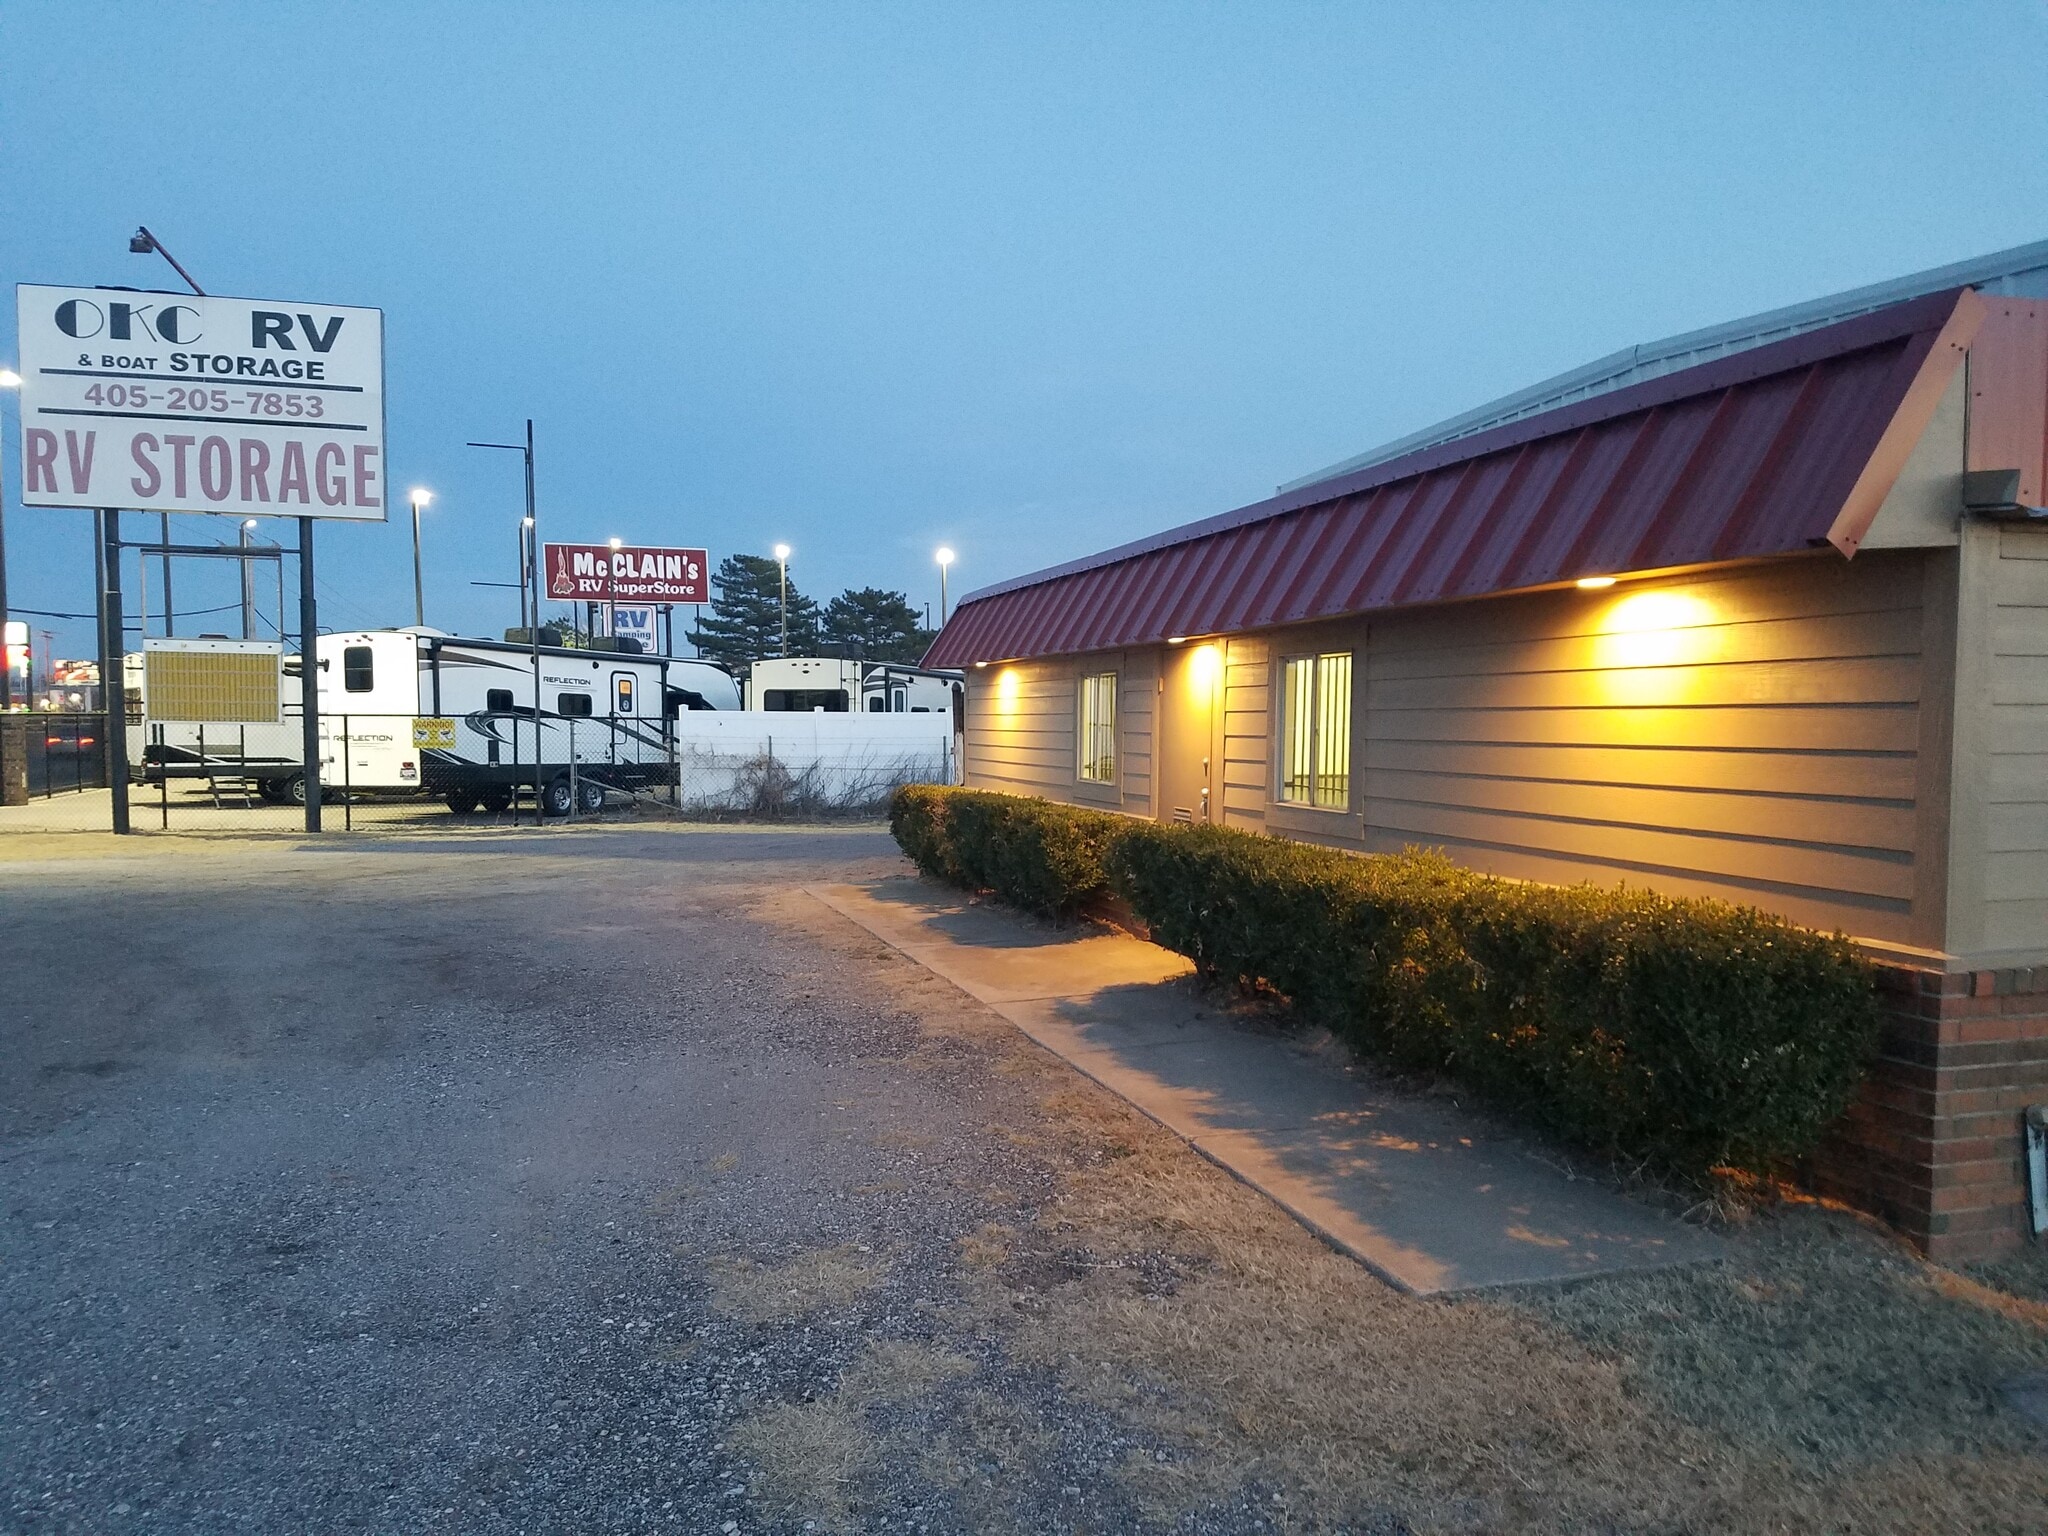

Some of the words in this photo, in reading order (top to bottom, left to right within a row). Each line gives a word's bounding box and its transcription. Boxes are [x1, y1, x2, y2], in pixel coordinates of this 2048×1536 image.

[54, 299, 203, 345] OKC
[251, 310, 345, 353] RV
[78, 353, 93, 366] &
[102, 355, 158, 370] BOAT
[170, 353, 325, 381] STORAGE
[84, 383, 324, 418] 405-205-7853
[26, 428, 96, 494] RV
[131, 432, 381, 508] STORAGE
[579, 579, 603, 592] RV
[608, 579, 695, 595] SuperStore
[614, 611, 648, 628] RV
[613, 630, 651, 640] amping
[543, 676, 591, 685] REFLECTION
